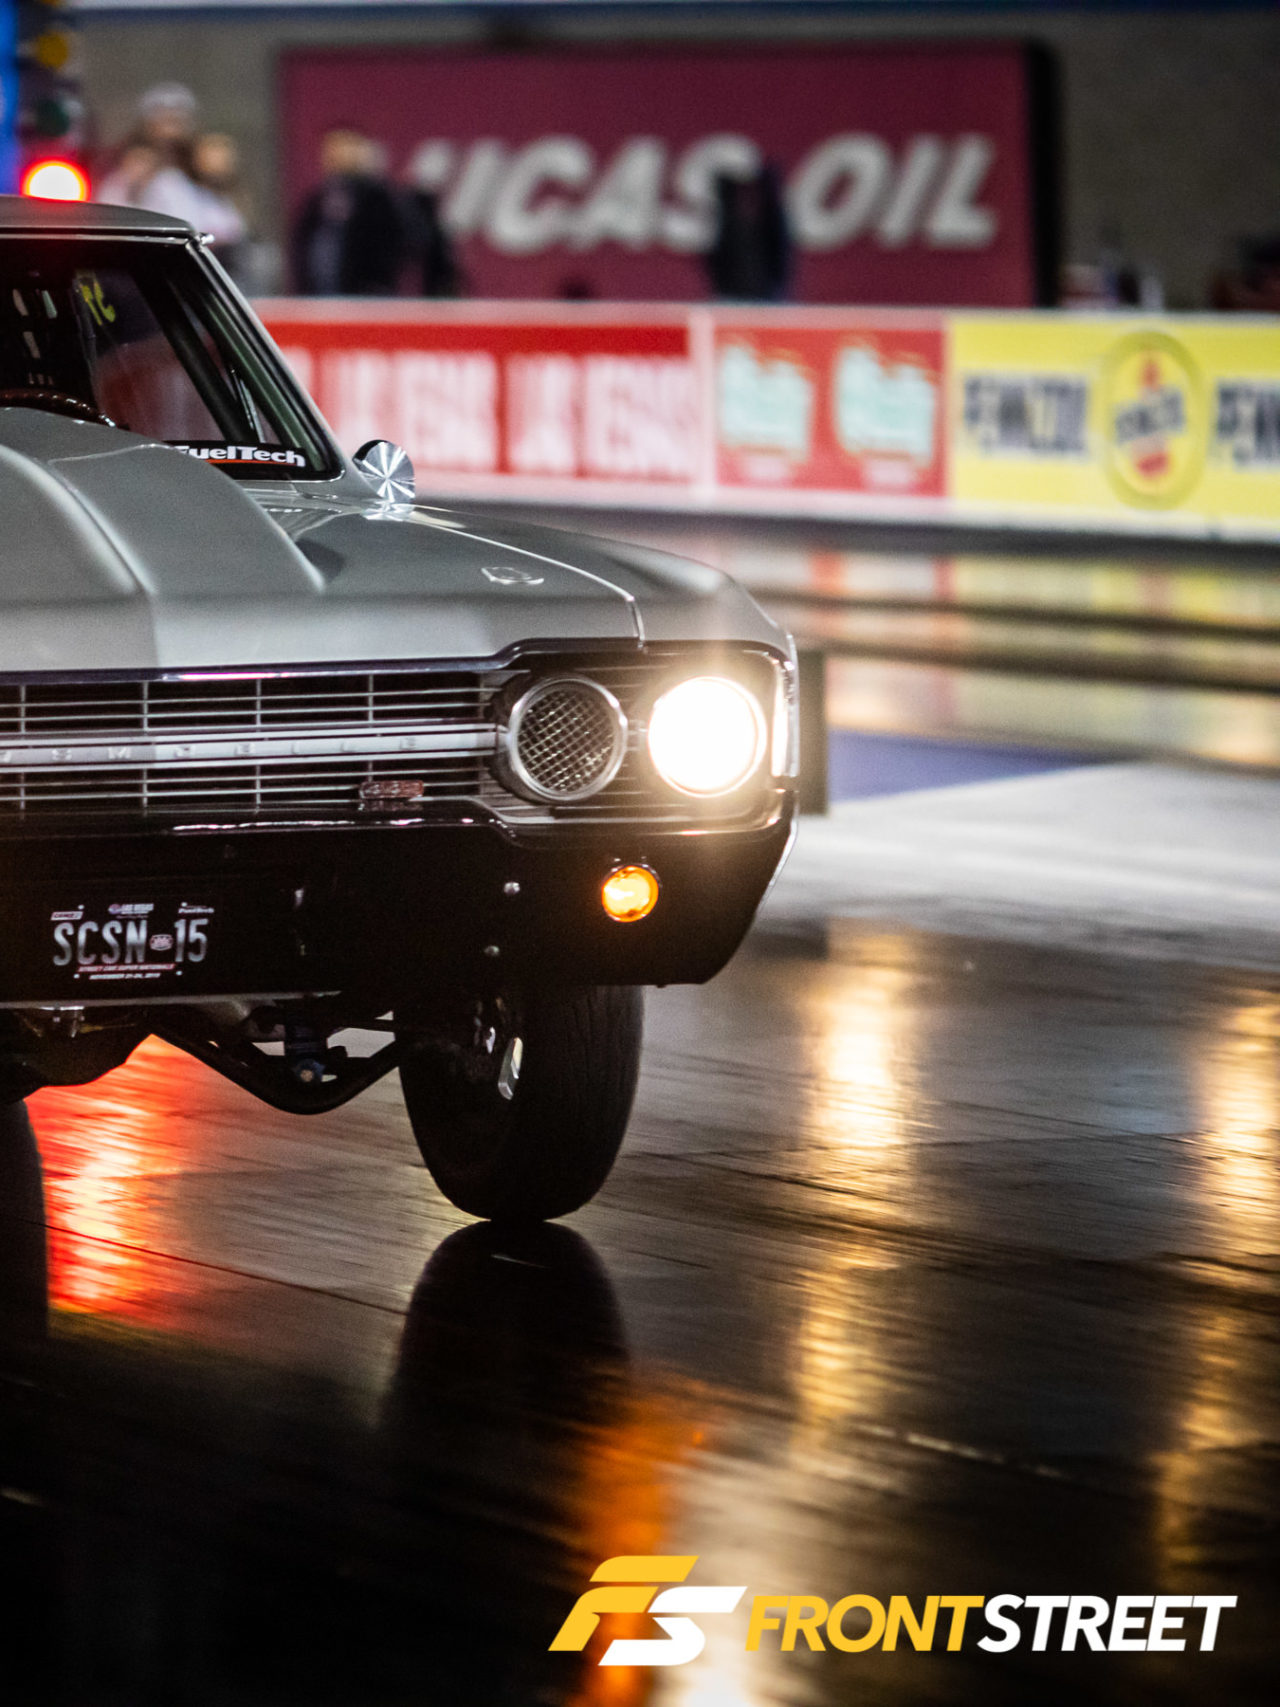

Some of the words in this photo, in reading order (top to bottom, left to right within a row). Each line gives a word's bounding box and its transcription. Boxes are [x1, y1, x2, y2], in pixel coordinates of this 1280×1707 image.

[784, 133, 1000, 252] OIL
[53, 919, 148, 966] SCSN
[174, 918, 209, 963] 15
